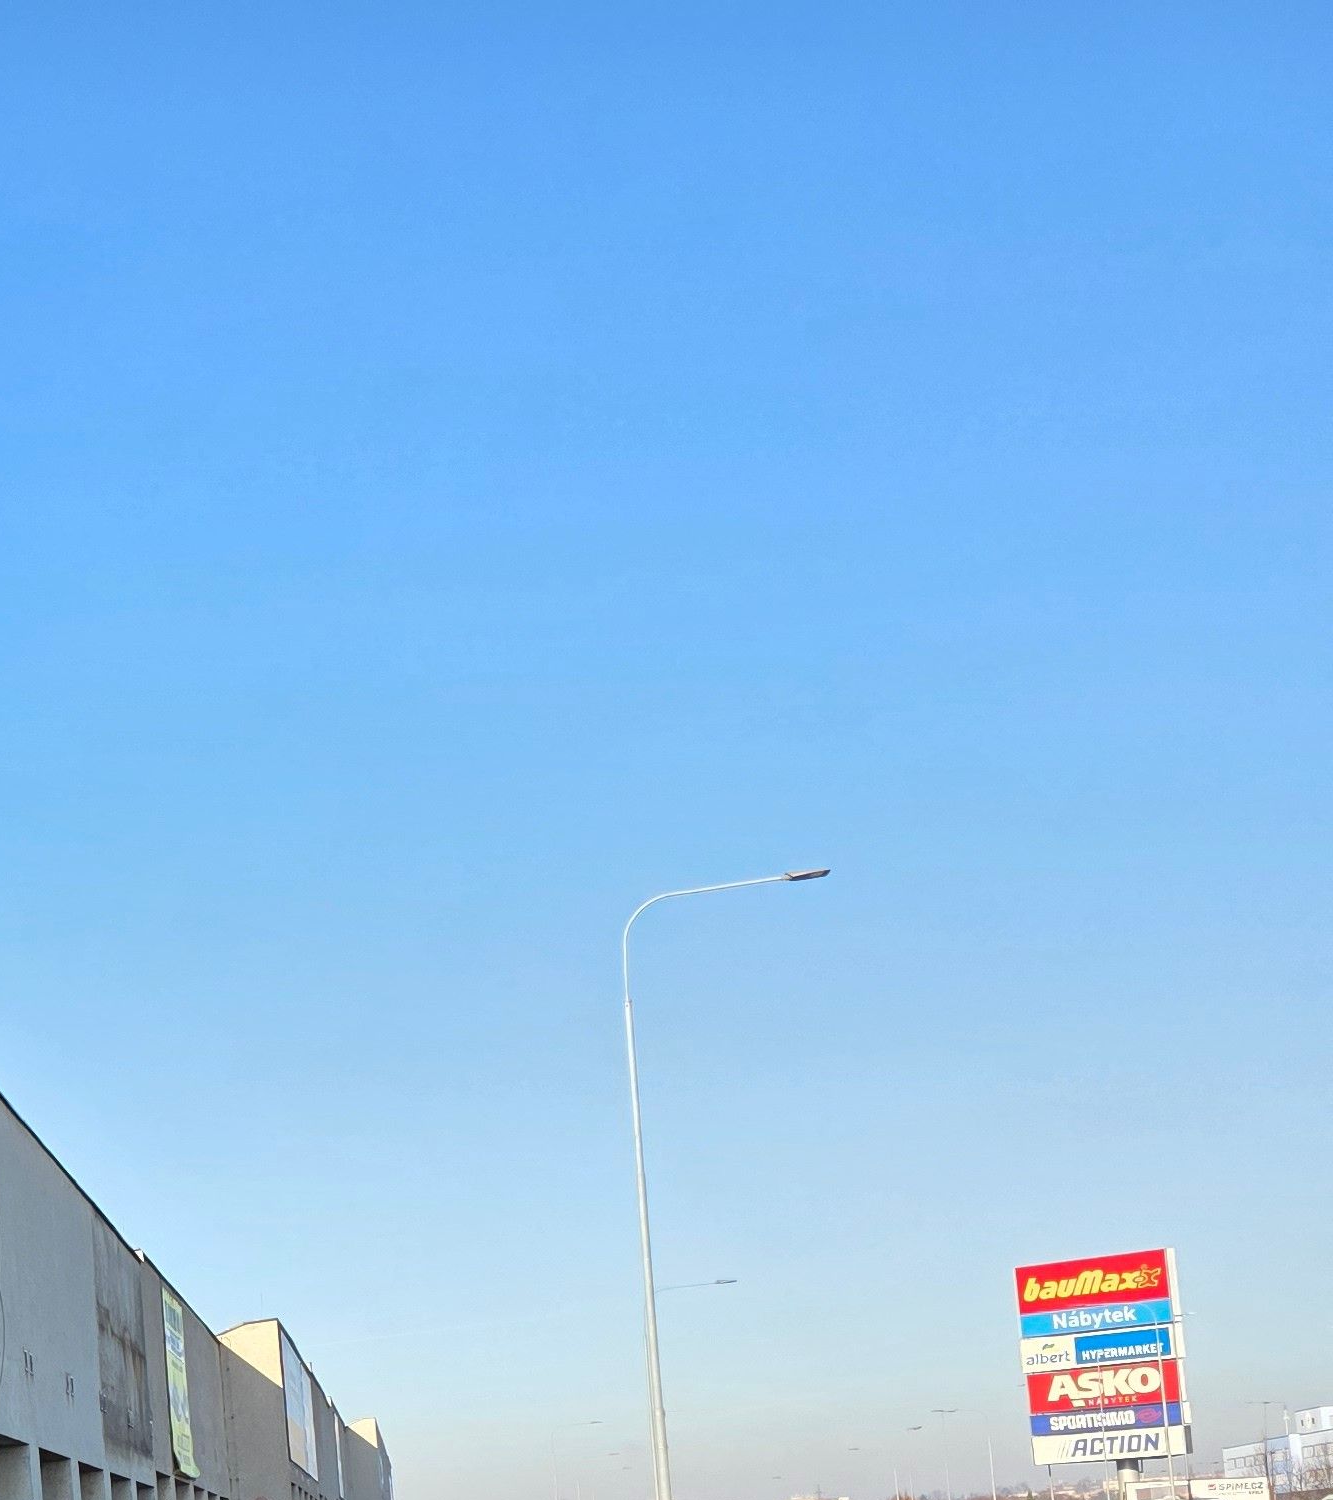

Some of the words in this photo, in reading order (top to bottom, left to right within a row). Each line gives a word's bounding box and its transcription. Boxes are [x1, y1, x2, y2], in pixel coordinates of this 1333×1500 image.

[1052, 1306, 1137, 1329] Nábytek
[1026, 1351, 1071, 1365] albert
[1082, 1342, 1164, 1361] HYPERMARKET
[1047, 1366, 1162, 1402] ASKO
[1071, 1432, 1160, 1458] ACTION
